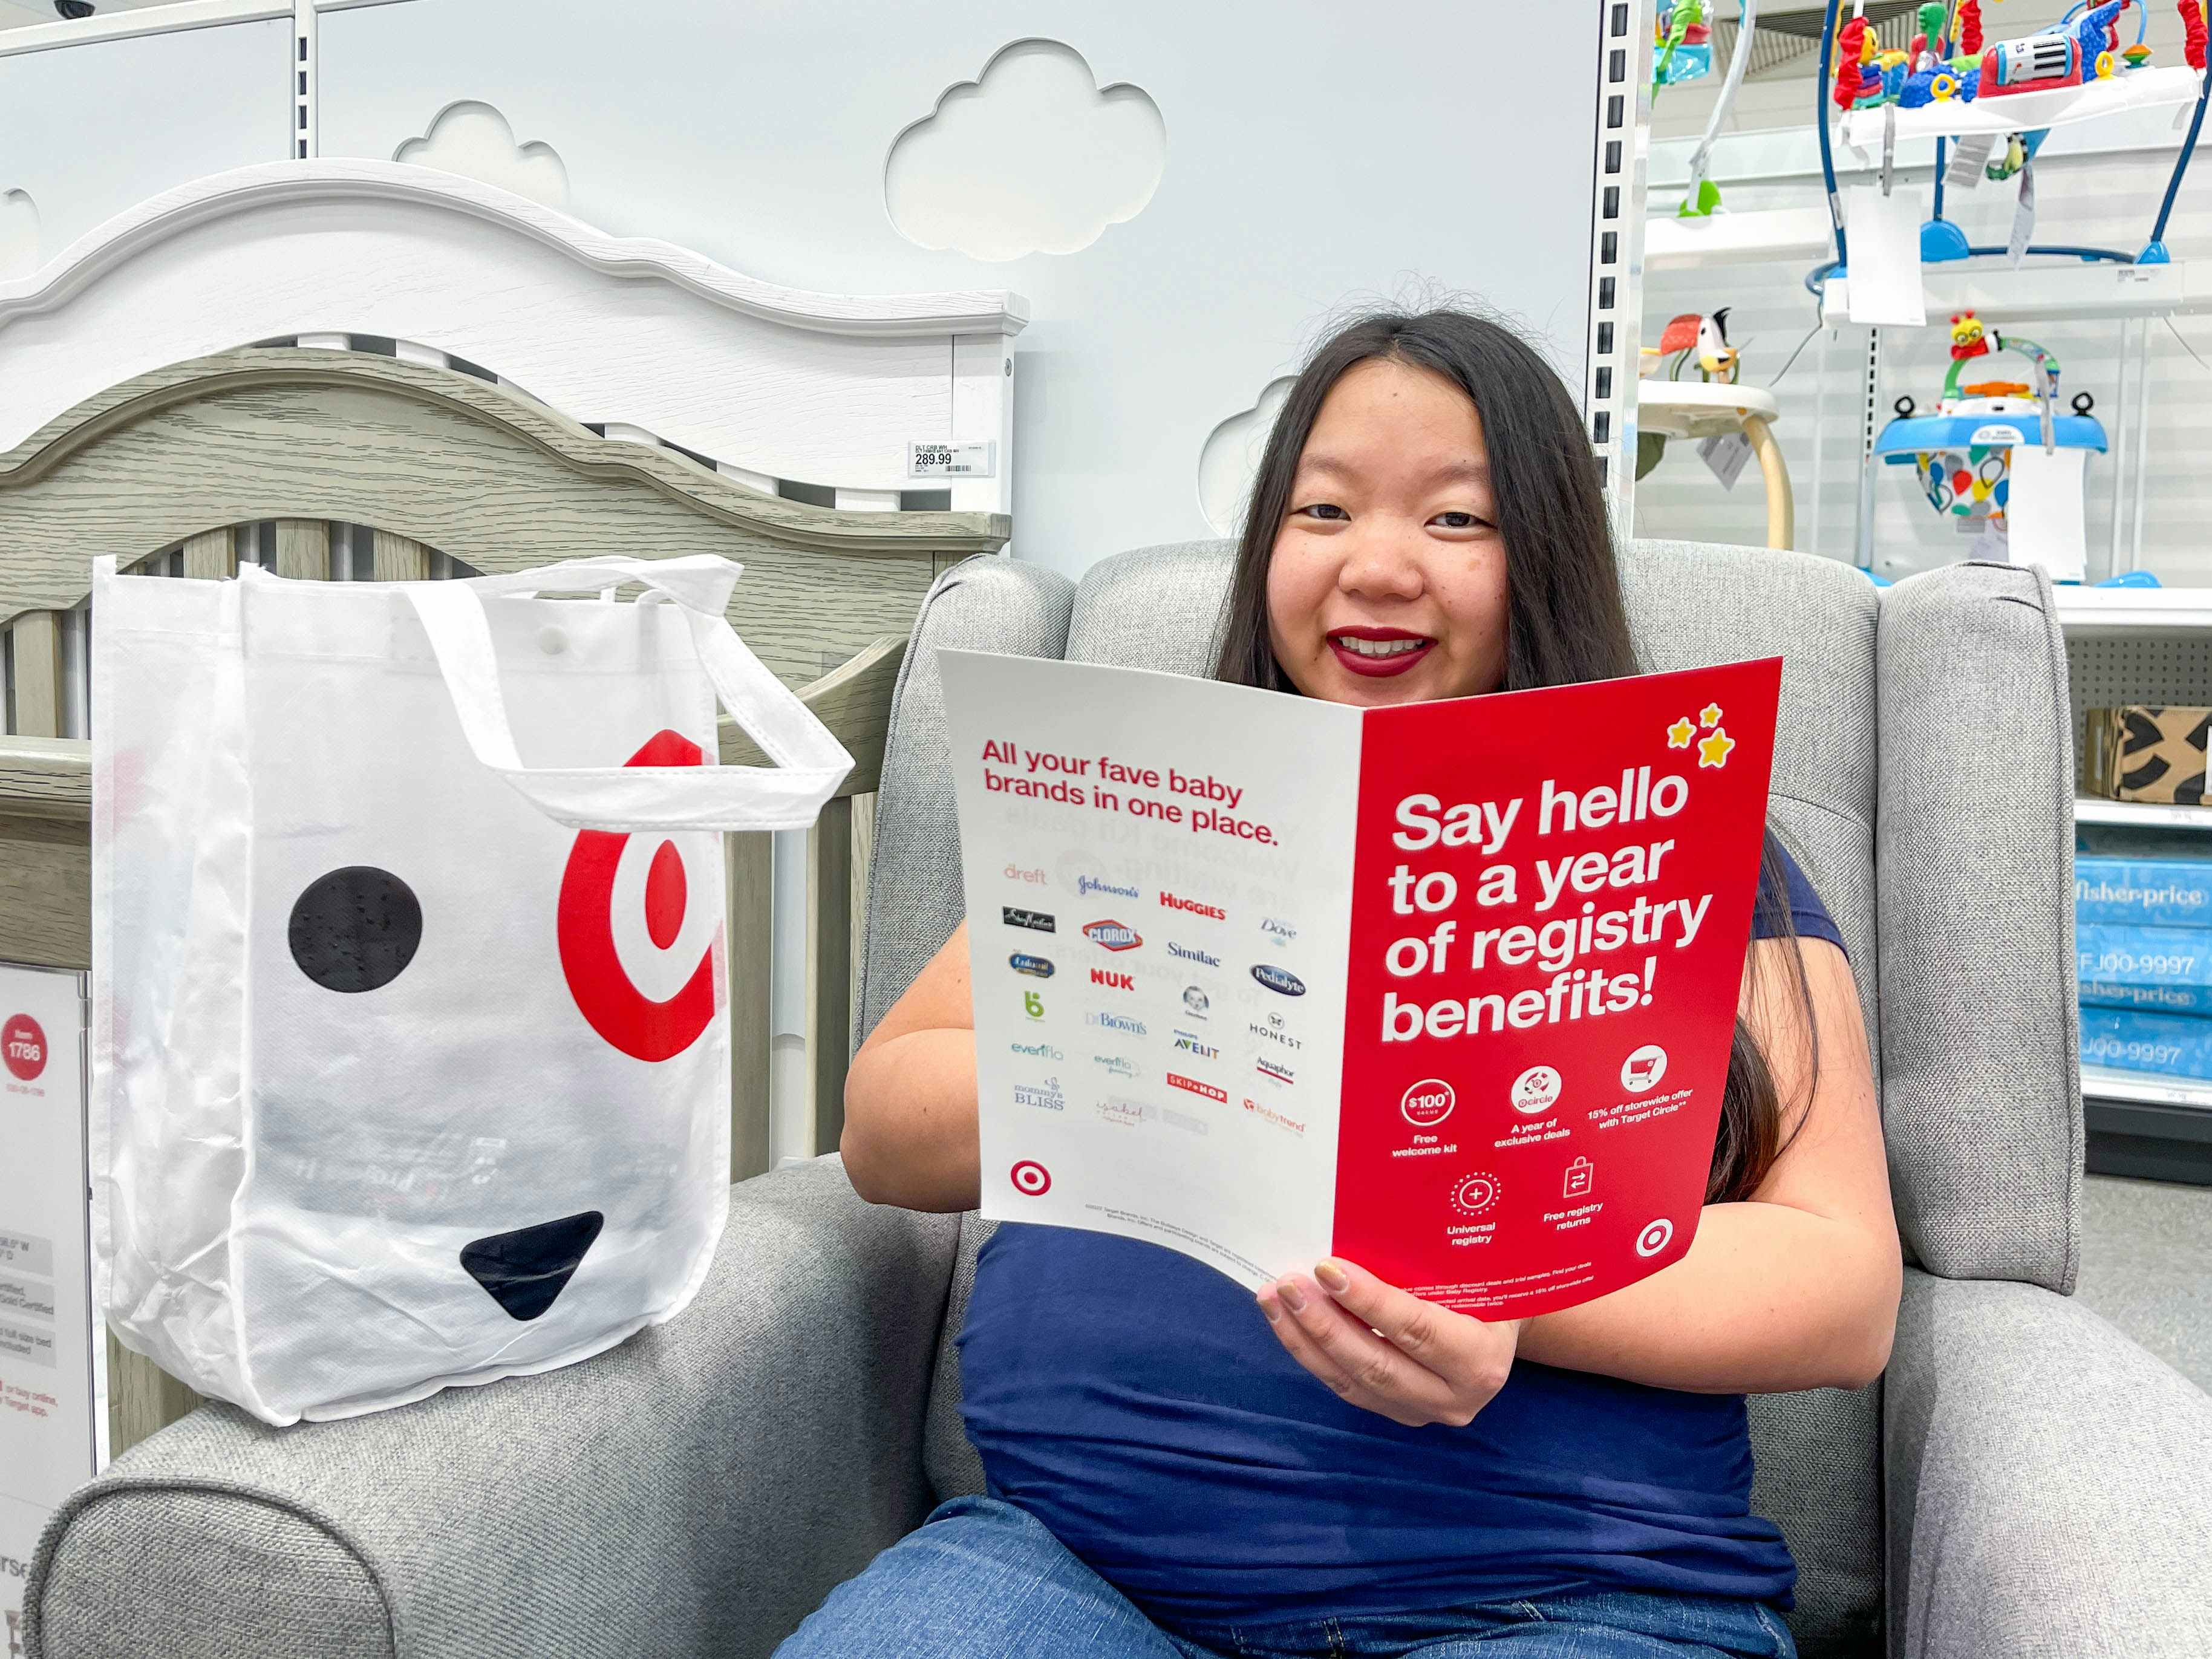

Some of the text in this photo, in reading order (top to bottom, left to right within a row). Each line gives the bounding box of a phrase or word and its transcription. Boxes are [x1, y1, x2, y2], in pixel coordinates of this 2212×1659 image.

[915, 453, 951, 464] 289.99
[982, 739, 1243, 809] All your fave baby
[984, 768, 1279, 847] brands in one place.
[1392, 766, 1689, 855] Say hello
[1004, 864, 1046, 885] dreft
[1388, 839, 1675, 914] to a year
[1160, 891, 1225, 920] HUGGIES
[1089, 927, 1137, 944] CLOROX
[1261, 918, 1296, 938] Dove
[1385, 894, 1714, 977] of registry
[1167, 941, 1219, 967] Similac
[1091, 967, 1134, 991] NUK
[1256, 968, 1305, 994] Pedialyte
[1382, 956, 1657, 1042] benefits!
[1250, 1022, 1302, 1050] HONEST
[8, 1041, 41, 1061] 1786
[1011, 1043, 1063, 1060] evenflo
[1258, 1056, 1294, 1077] Aquaphor
[1170, 1074, 1225, 1100] SKIP HOP
[1014, 1092, 1065, 1111] BLISS
[1528, 1095, 1553, 1106] circle
[1587, 1089, 1693, 1120] 15% off storewide offer
[1511, 1118, 1558, 1134] A year of
[1599, 1118, 1619, 1129] with
[1621, 1110, 1651, 1124] Target
[1414, 1135, 1438, 1144] Free
[1494, 1128, 1571, 1147] exclusive deals
[1392, 1143, 1457, 1158] welcome kit
[1544, 1202, 1603, 1222] Free registry
[1447, 1222, 1496, 1234] Universal
[1556, 1216, 1591, 1230] returns
[1452, 1234, 1492, 1246] registry
